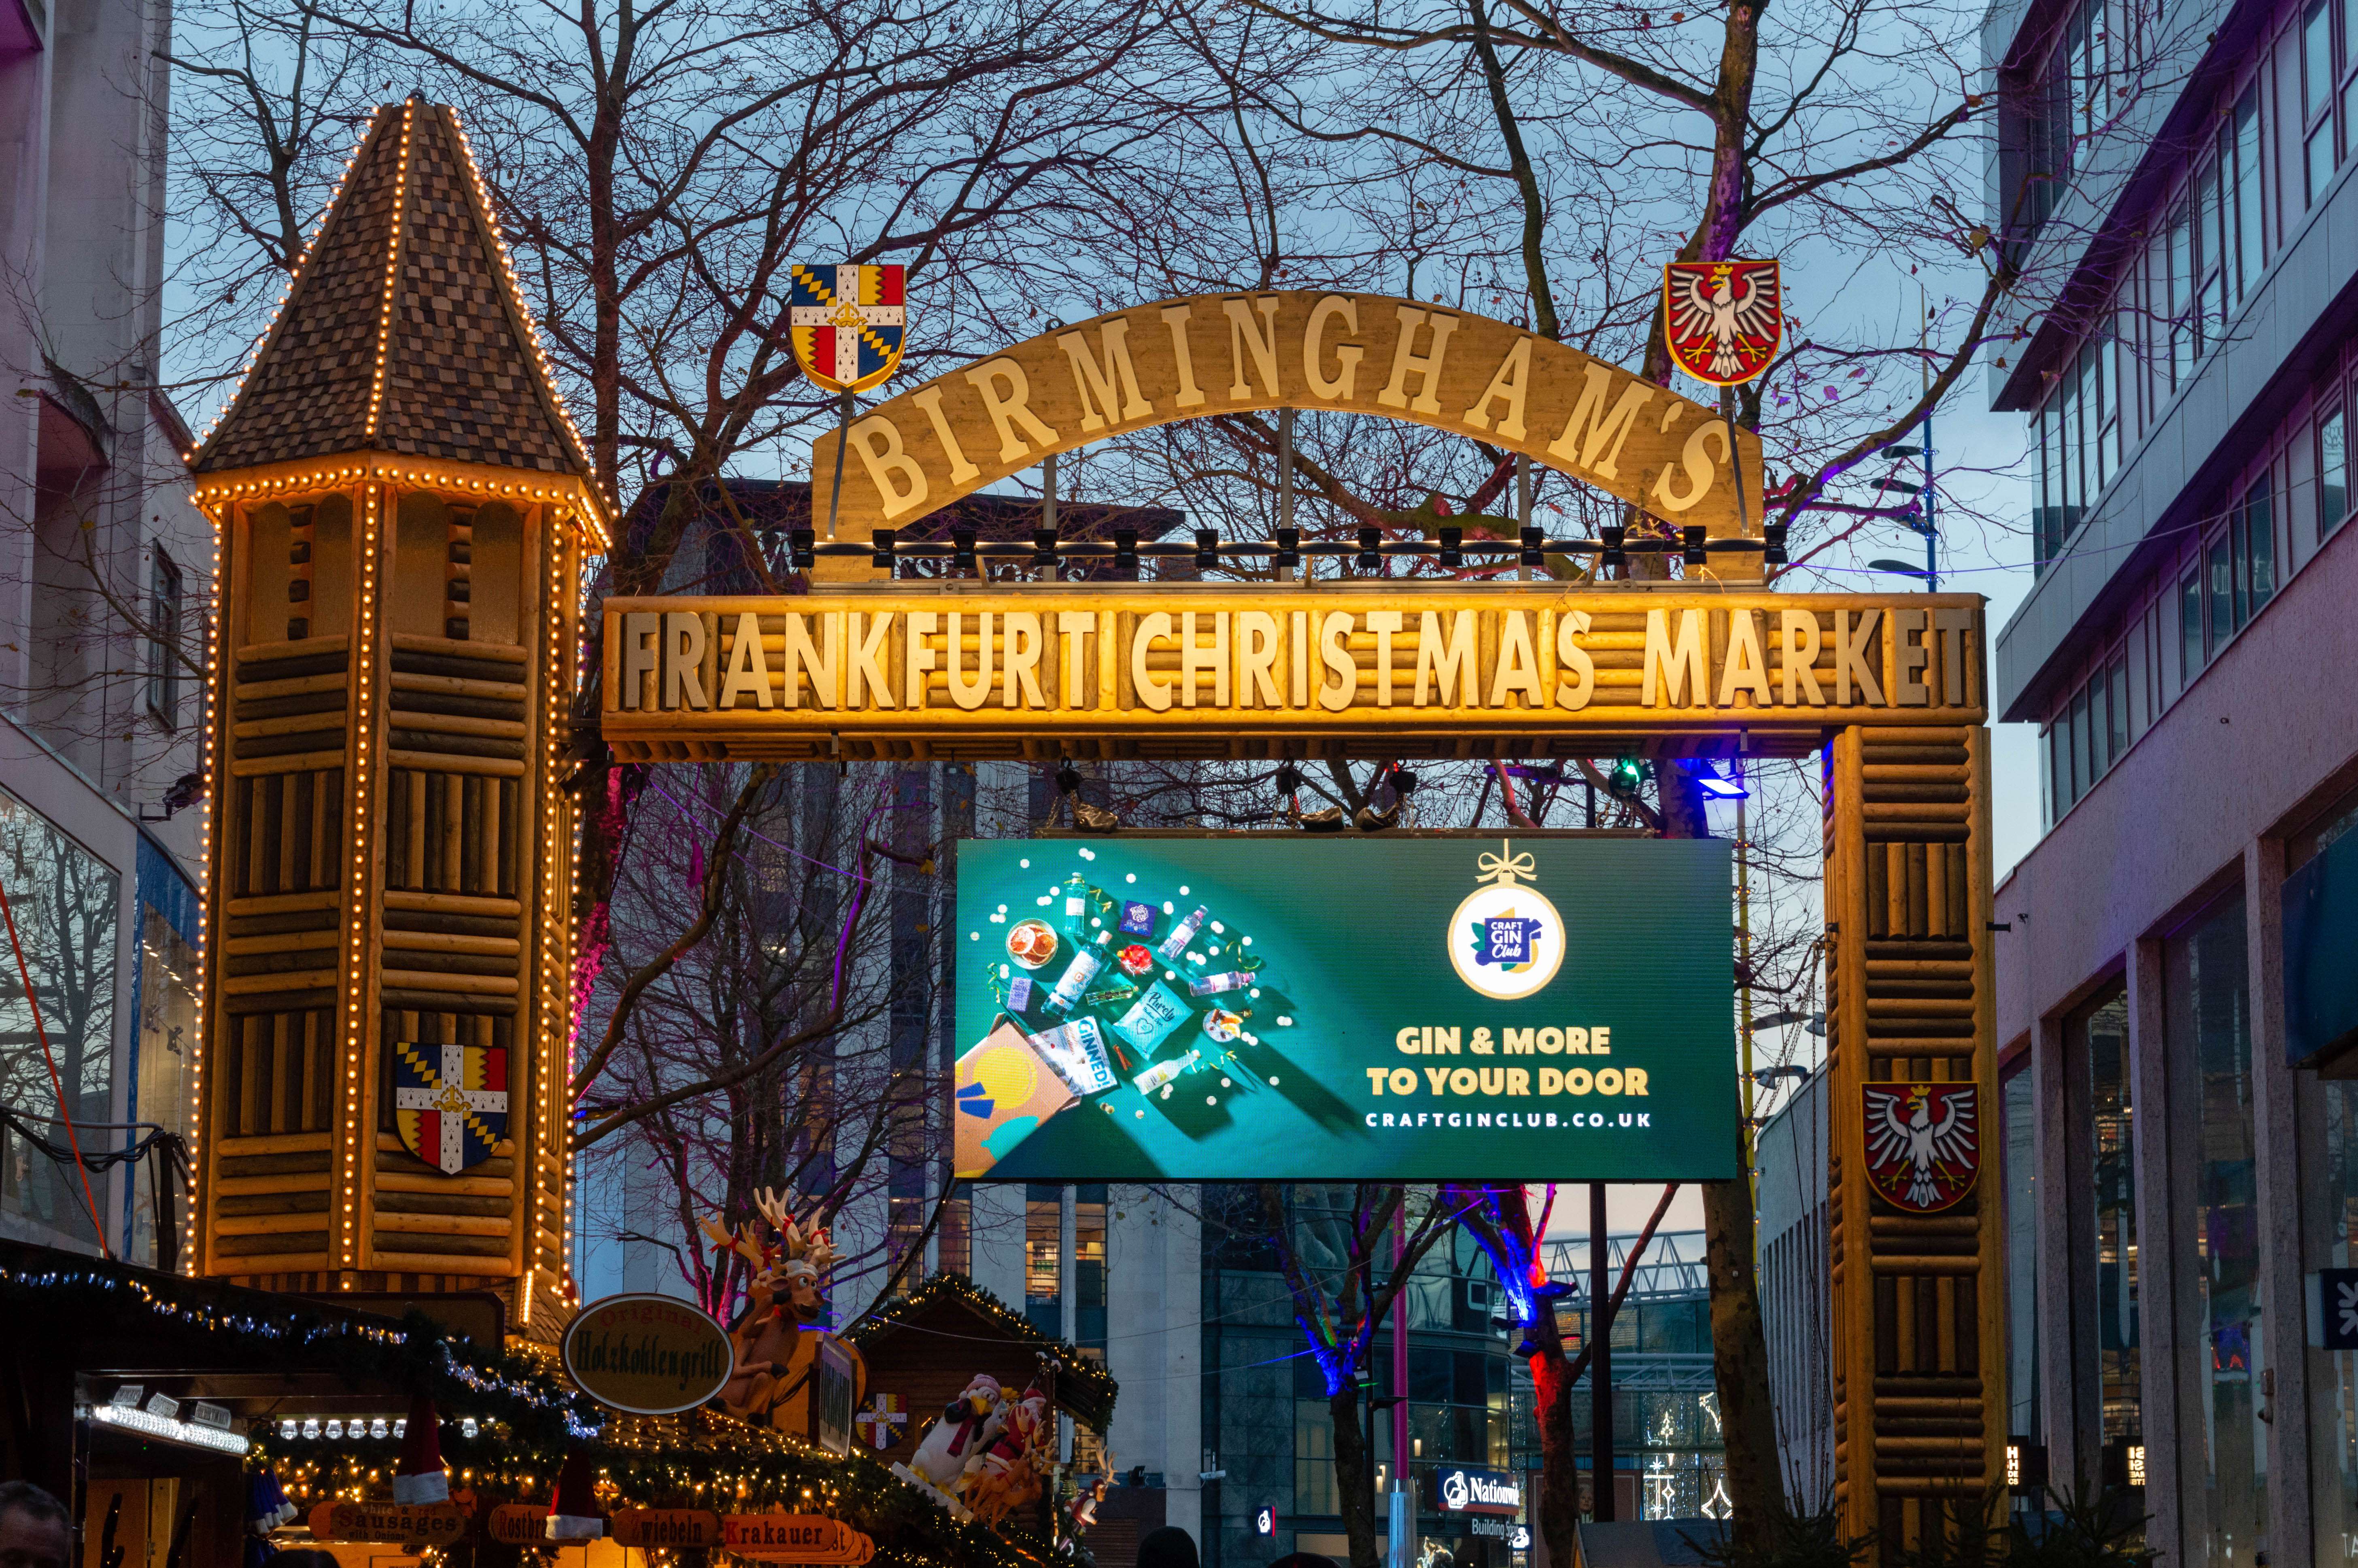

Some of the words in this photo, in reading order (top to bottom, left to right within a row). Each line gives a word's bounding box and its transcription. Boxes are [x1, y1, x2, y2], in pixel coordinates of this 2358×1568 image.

[848, 295, 1733, 520] BIRMINGHAM'S
[624, 610, 1094, 711] FRANKFURT
[1131, 610, 1594, 711] CHRISTMAS
[1641, 609, 1971, 706] MARKET
[1491, 922, 1523, 930] CRAFT
[1491, 930, 1521, 943] GIN
[1492, 944, 1521, 958] Club
[1396, 1027, 1461, 1054] GIN
[1470, 1027, 1495, 1054] &
[1503, 1027, 1610, 1054] MORE
[1077, 1020, 1110, 1088] GINNED!
[1366, 1068, 1418, 1095] TO
[1424, 1068, 1531, 1095] YOUR
[1539, 1068, 1649, 1095] DOOR
[1365, 1113, 1651, 1127] CRAFTGINCLUB.CO.UK
[599, 1303, 704, 1334] Original
[575, 1330, 723, 1391] Holzkohlengrill
[361, 1505, 393, 1515] white
[339, 1511, 457, 1536] Sausages
[724, 1521, 823, 1545] Krakauer
[1472, 1519, 1504, 1540] Building
